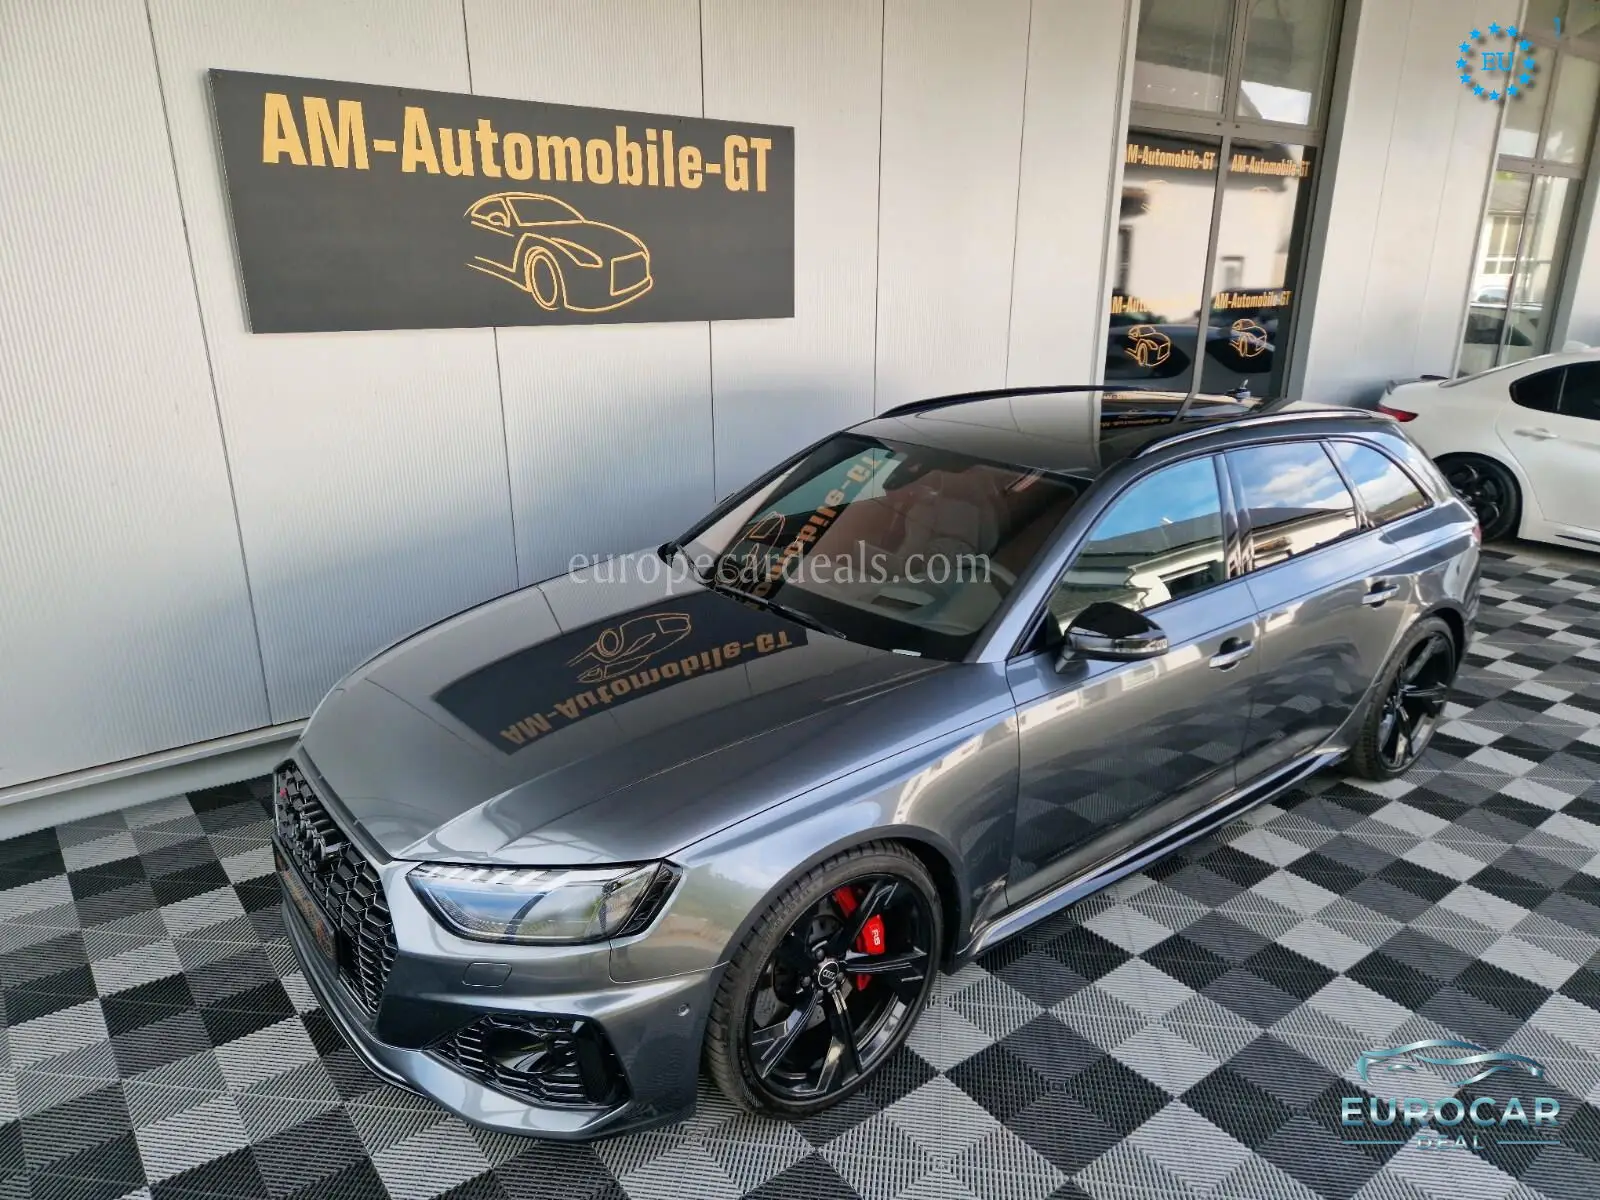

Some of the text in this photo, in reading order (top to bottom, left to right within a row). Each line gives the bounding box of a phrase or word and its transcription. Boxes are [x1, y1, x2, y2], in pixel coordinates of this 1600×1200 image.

[262, 92, 772, 192] AM-Automobile-GT
[1125, 143, 1216, 171] M-Automobile-GT
[1230, 153, 1311, 177] AM-Automobile-GT
[1213, 290, 1292, 310] AM-Automobile-GT
